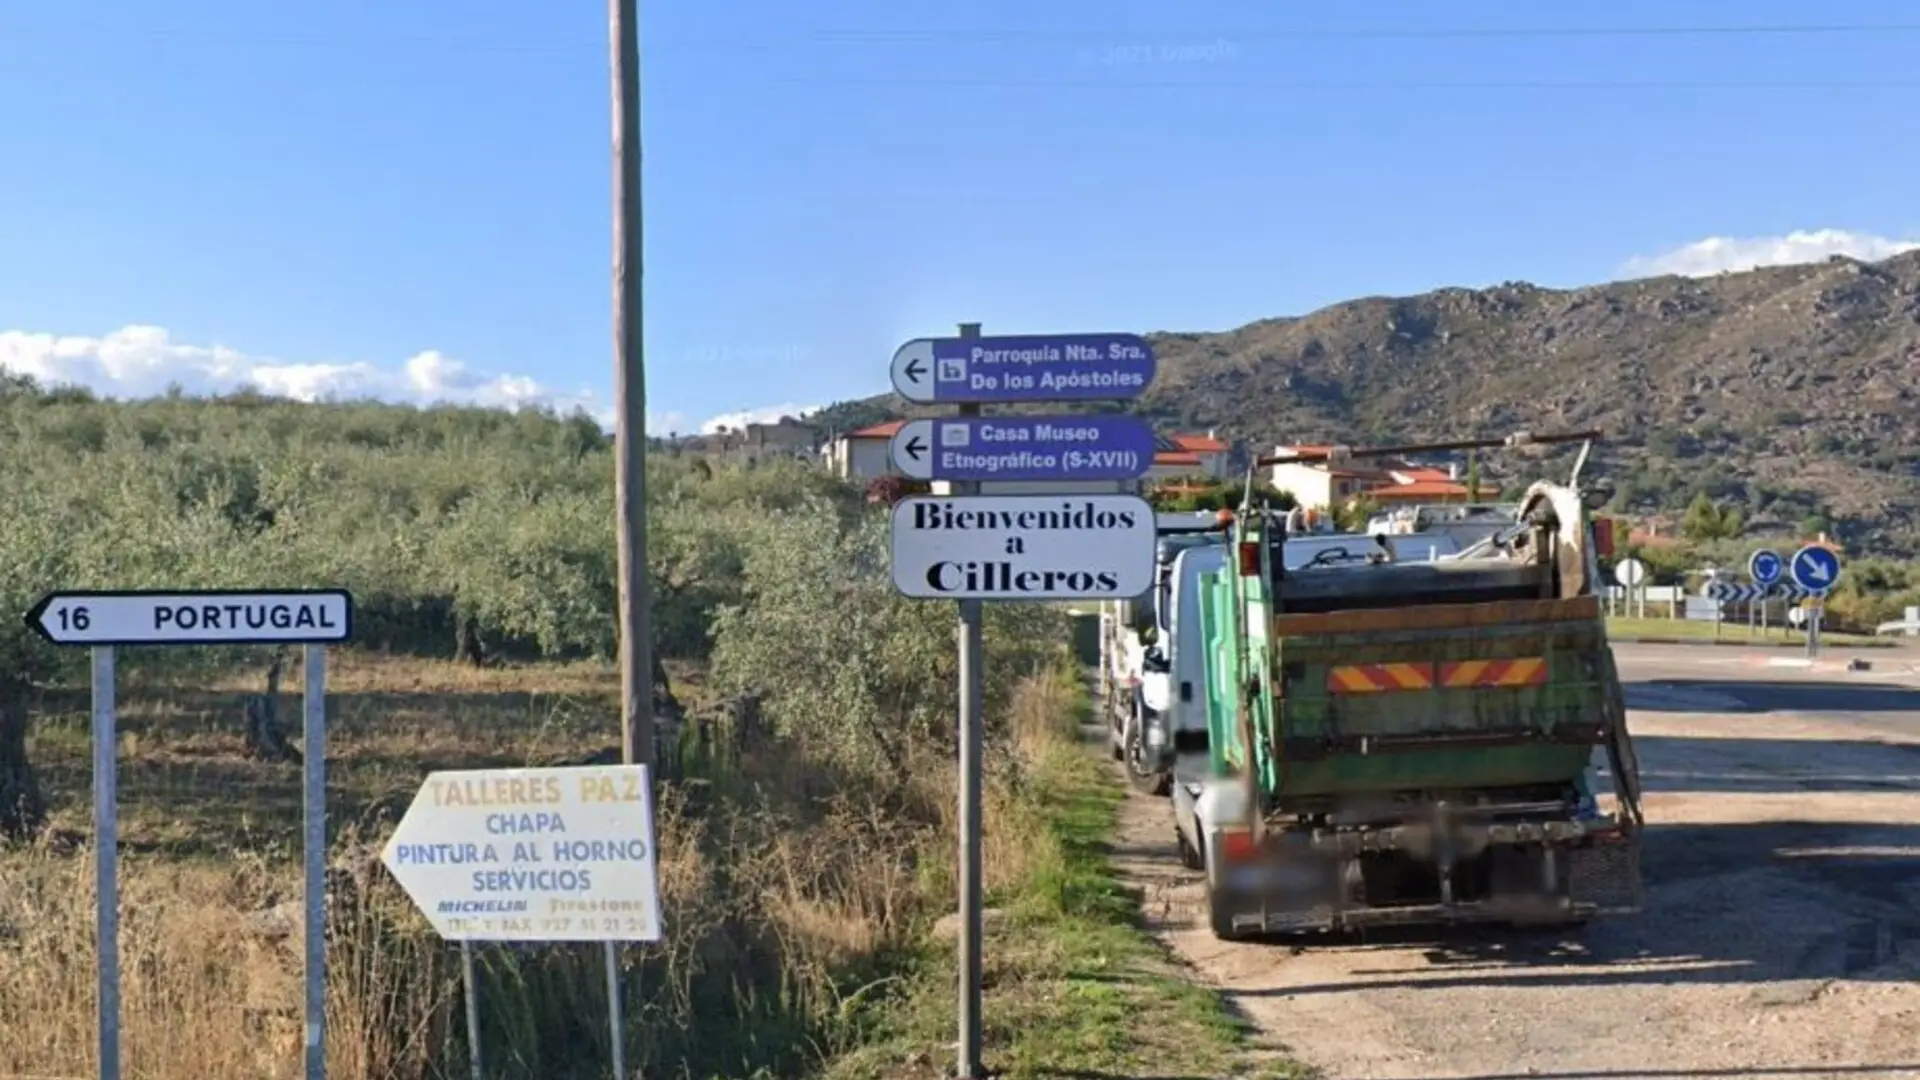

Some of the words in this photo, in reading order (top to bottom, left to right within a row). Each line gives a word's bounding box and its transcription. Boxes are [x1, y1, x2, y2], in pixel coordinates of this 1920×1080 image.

[971, 345, 1060, 366] Parroquia
[1065, 345, 1103, 362] Nta.
[1108, 343, 1146, 360] Sra.
[971, 373, 997, 390] De
[1004, 371, 1033, 389] los
[1040, 369, 1144, 391] Apóstoles
[980, 424, 1029, 441] Casa
[1035, 424, 1099, 441] Museo
[942, 450, 1056, 472] Etnográfico
[1062, 450, 1138, 471] (S-XVII)
[913, 502, 1135, 529] Bienvenidos
[1005, 536, 1025, 554] a
[926, 561, 1118, 592] Cilleros
[57, 606, 91, 631] 16
[154, 604, 336, 630] PORTUGAL
[429, 776, 562, 807] TALLERES
[580, 774, 641, 803] PAZ
[486, 812, 566, 834] CHAPA
[397, 842, 499, 865] PINTURA
[512, 842, 541, 863] AL
[554, 839, 646, 862] HORNO
[473, 870, 592, 892] SERVICIOS
[437, 899, 527, 913] MICHELIN
